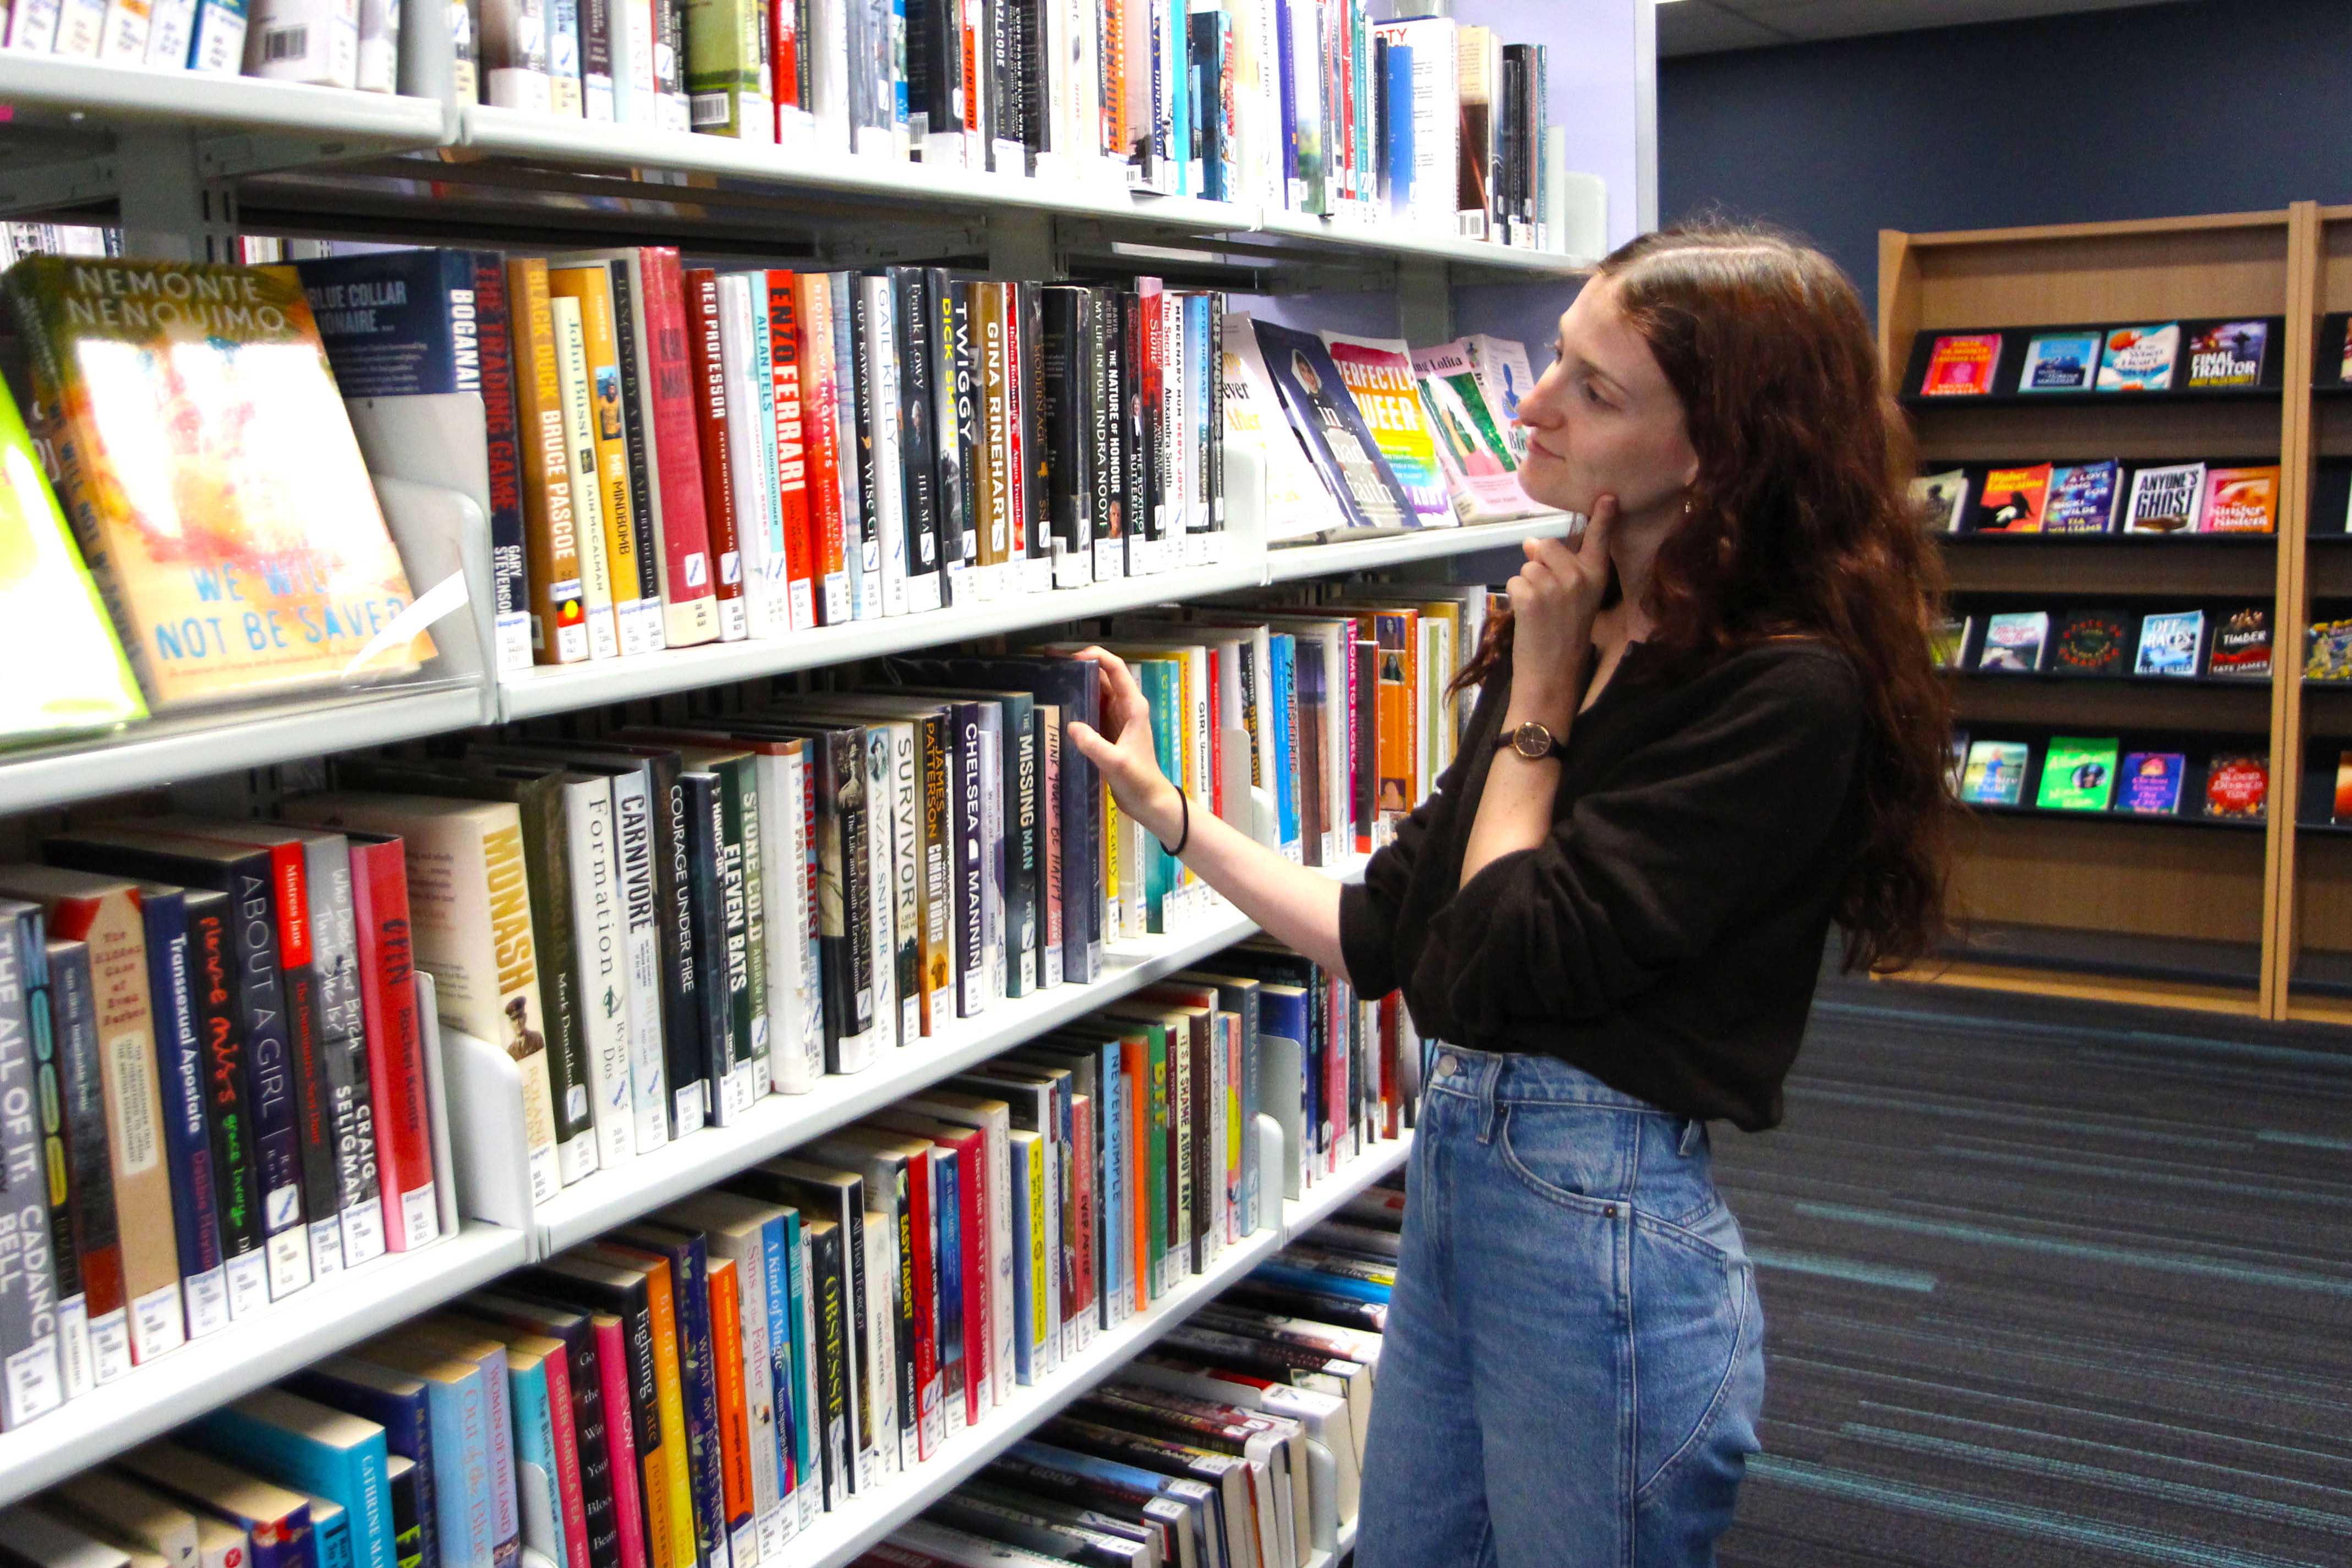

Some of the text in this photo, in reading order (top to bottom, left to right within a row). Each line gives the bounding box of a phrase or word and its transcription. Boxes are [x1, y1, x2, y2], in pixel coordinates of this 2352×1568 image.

[67, 297, 287, 333] NENQUIMO
[75, 266, 260, 303] NEMONTE
[348, 281, 407, 305] COLLAR
[1095, 301, 1102, 320] MY
[757, 316, 773, 411] ALLAN FELS
[910, 283, 926, 388] Frank Lowy
[1096, 354, 1103, 367] IN
[1149, 319, 1159, 364] Stone
[2191, 352, 2233, 366] FINAL
[475, 266, 518, 512] THE TRADING GAME
[704, 320, 726, 419] PROFESSOR
[770, 288, 806, 492] ENZO FERRARI
[813, 284, 833, 467] RIDING WITH GIANTS
[877, 289, 898, 447] GAIL KELLY
[942, 298, 956, 447] DICK SMITH
[954, 301, 972, 440] TWIGGY
[1034, 344, 1044, 446] MODERN AGE
[1108, 369, 1119, 419] NATURE
[2191, 360, 2256, 377] TRAITOR
[525, 270, 575, 560] BLACK DUCK BRUCE PASCOE
[986, 321, 1005, 527] GINA RINEHART
[1096, 409, 1106, 465] INDRA
[1111, 423, 1117, 434] OF
[1317, 398, 1342, 429] in
[1109, 437, 1120, 493] HONOUR
[1322, 431, 1374, 463] bad
[1097, 471, 1107, 526] NOOYI
[1130, 453, 1139, 524] BUTTERFLY
[1344, 469, 1396, 503] faith
[2137, 489, 2194, 517] GHOST
[2140, 469, 2198, 491] ANYONE'S
[612, 481, 631, 555] MINDBOMB
[191, 562, 244, 602] WE
[507, 545, 522, 576] GARY
[154, 608, 288, 661] NOT BE
[2147, 632, 2192, 648] RACES
[2151, 618, 2178, 634] OFF
[2223, 630, 2267, 646] TIMBER
[1349, 683, 1355, 704] TO
[1249, 705, 1258, 747] DIRTY
[926, 721, 936, 838] PATTERSON
[934, 745, 944, 812] JAMES
[965, 722, 978, 831] CHELSEA
[1018, 734, 1034, 827] MISSING
[802, 761, 819, 941] ESCAPE ARTIST
[847, 812, 855, 832] The
[897, 738, 916, 908] SURVIVOR
[1021, 830, 1033, 869] MAN
[588, 798, 617, 977] Formation
[620, 795, 653, 934] CARNIVORE
[670, 785, 694, 993] COURAGE UNDER FIRE
[742, 791, 762, 994] STONE COLD ANDREW
[849, 879, 857, 908] Death
[875, 787, 888, 957] ANZAC SNIPER
[928, 844, 942, 896] COMBAT
[285, 864, 303, 946] Mistress Jane
[482, 824, 535, 996] MONASH
[722, 842, 747, 993] ELEVEN BATS
[851, 911, 858, 922] of
[239, 875, 287, 1118] ABOUT A GIRL
[556, 972, 570, 1012] Mark
[0, 1017, 28, 1081] ALL
[168, 933, 204, 1133] Transsexual Apostate
[2, 1087, 36, 1134] OF
[354, 1104, 376, 1180] CRAIG
[1111, 1055, 1120, 1202] NEVER SIMPLE
[1180, 1035, 1190, 1211] IT'S A SHAME ABOUT RAY
[0, 1213, 23, 1293] BELL
[899, 1213, 910, 1254] EASY
[1081, 1233, 1090, 1278] AFTER
[745, 1244, 768, 1390] Sins Father
[767, 1240, 785, 1370] A Kind of Magic
[902, 1257, 912, 1319] TARGET
[579, 1351, 595, 1367] Go
[633, 1307, 655, 1399] Fighting
[697, 1335, 710, 1388] WHAT
[703, 1396, 713, 1421] MY
[555, 1373, 581, 1524] GREEN VANILLA TEA
[359, 1455, 385, 1537] CATHRINE
[499, 1493, 511, 1534] LAND
